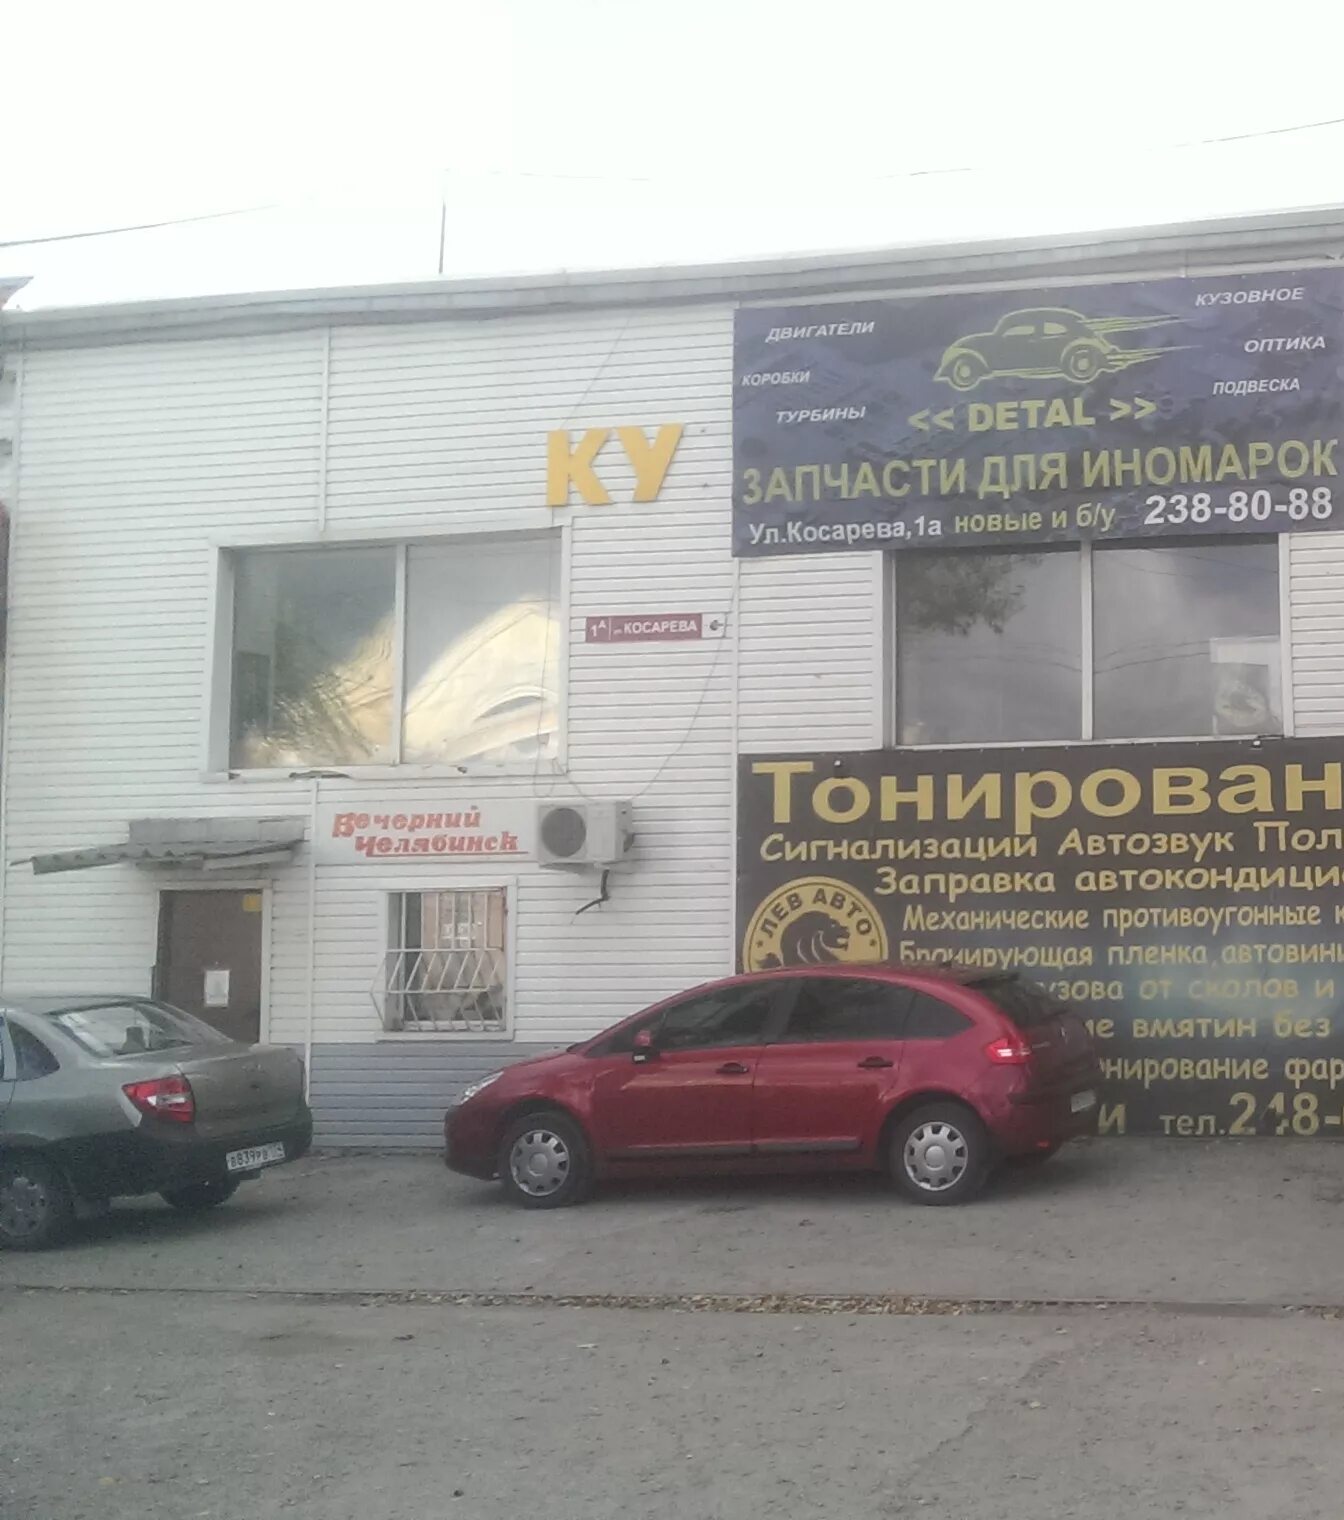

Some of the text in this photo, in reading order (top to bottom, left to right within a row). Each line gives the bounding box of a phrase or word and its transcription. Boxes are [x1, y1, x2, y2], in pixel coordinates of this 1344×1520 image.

[1195, 288, 1304, 307] КУЗОВНОЕ
[765, 321, 875, 343] ДВИГАТЕЛИ
[1244, 335, 1326, 353] ОПТИКА
[742, 370, 810, 387] КОРОБКИ
[1213, 377, 1300, 396] ПОДВЕСКА
[775, 406, 866, 424] ТУРБИНЫ
[968, 400, 1095, 432] DETAL
[546, 423, 685, 507] КУ
[743, 439, 1338, 505] ЗАПЧАСТИ ДЛЯ ИНОМАРОК
[955, 509, 1041, 533] новые
[1052, 511, 1067, 528] и
[1077, 502, 1115, 531] б/у
[1144, 488, 1333, 525] 238-80-88
[624, 620, 698, 634] КОСАРЕВА
[332, 805, 481, 838] Вечерний
[355, 831, 518, 857] Челябинск
[760, 834, 1037, 862] Сигнализации
[1058, 828, 1234, 862] Автозвук
[874, 867, 1055, 902] Заправка
[761, 887, 872, 938] ЛЕВ АВТО
[903, 905, 1089, 931] Механические
[1103, 906, 1321, 935] противоугонные
[1139, 979, 1173, 999] от
[1188, 977, 1299, 1000] сколов
[1315, 979, 1335, 999] и
[1133, 1017, 1256, 1038] вмятин
[1273, 1010, 1331, 1038] без
